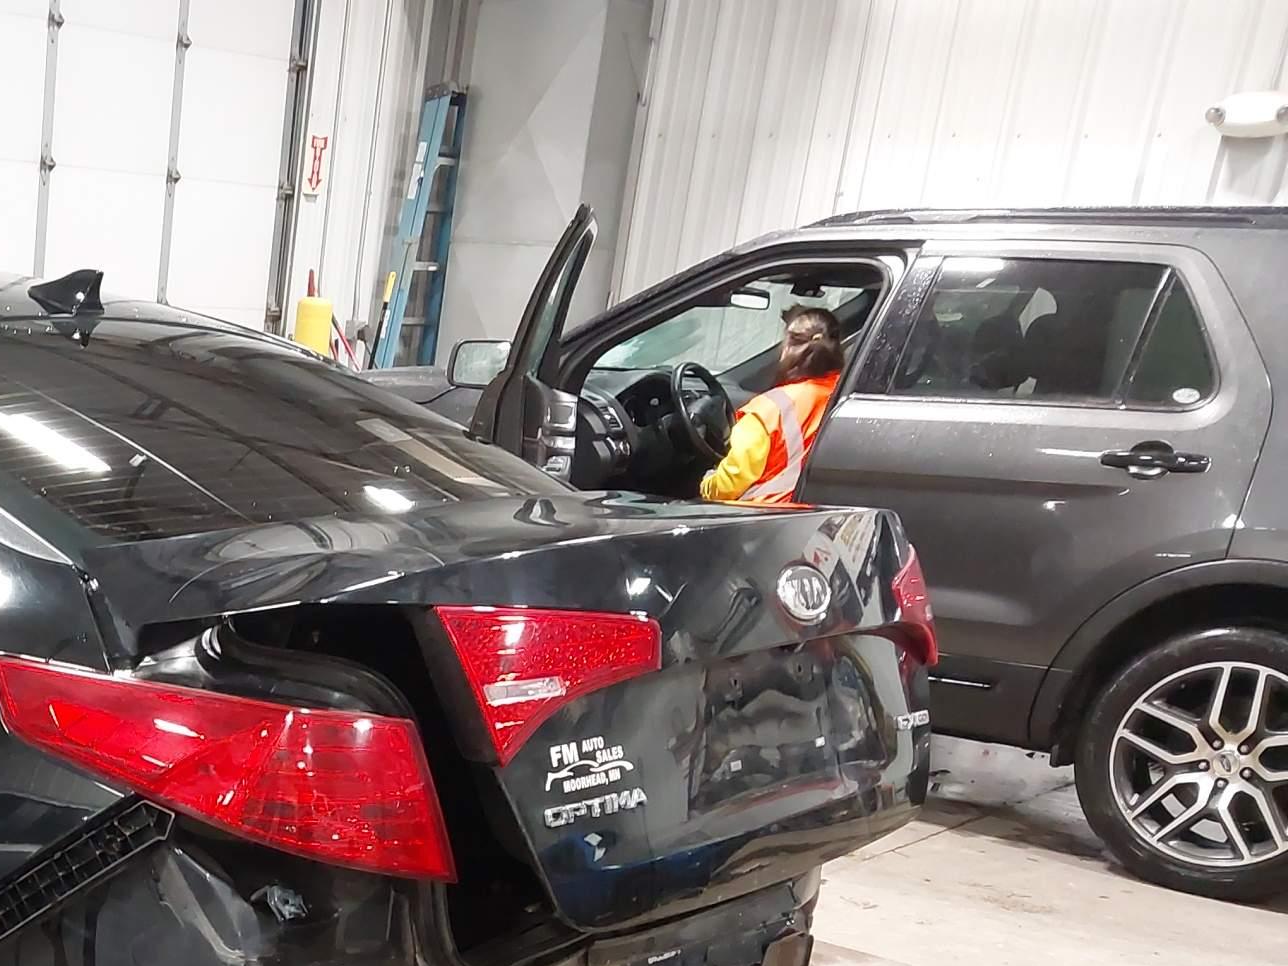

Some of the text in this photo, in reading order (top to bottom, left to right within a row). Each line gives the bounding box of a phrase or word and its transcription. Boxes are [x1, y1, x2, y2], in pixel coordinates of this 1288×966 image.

[550, 736, 605, 767] FM AUTO
[595, 745, 624, 763] SALES
[544, 787, 648, 828] OPTIMA
